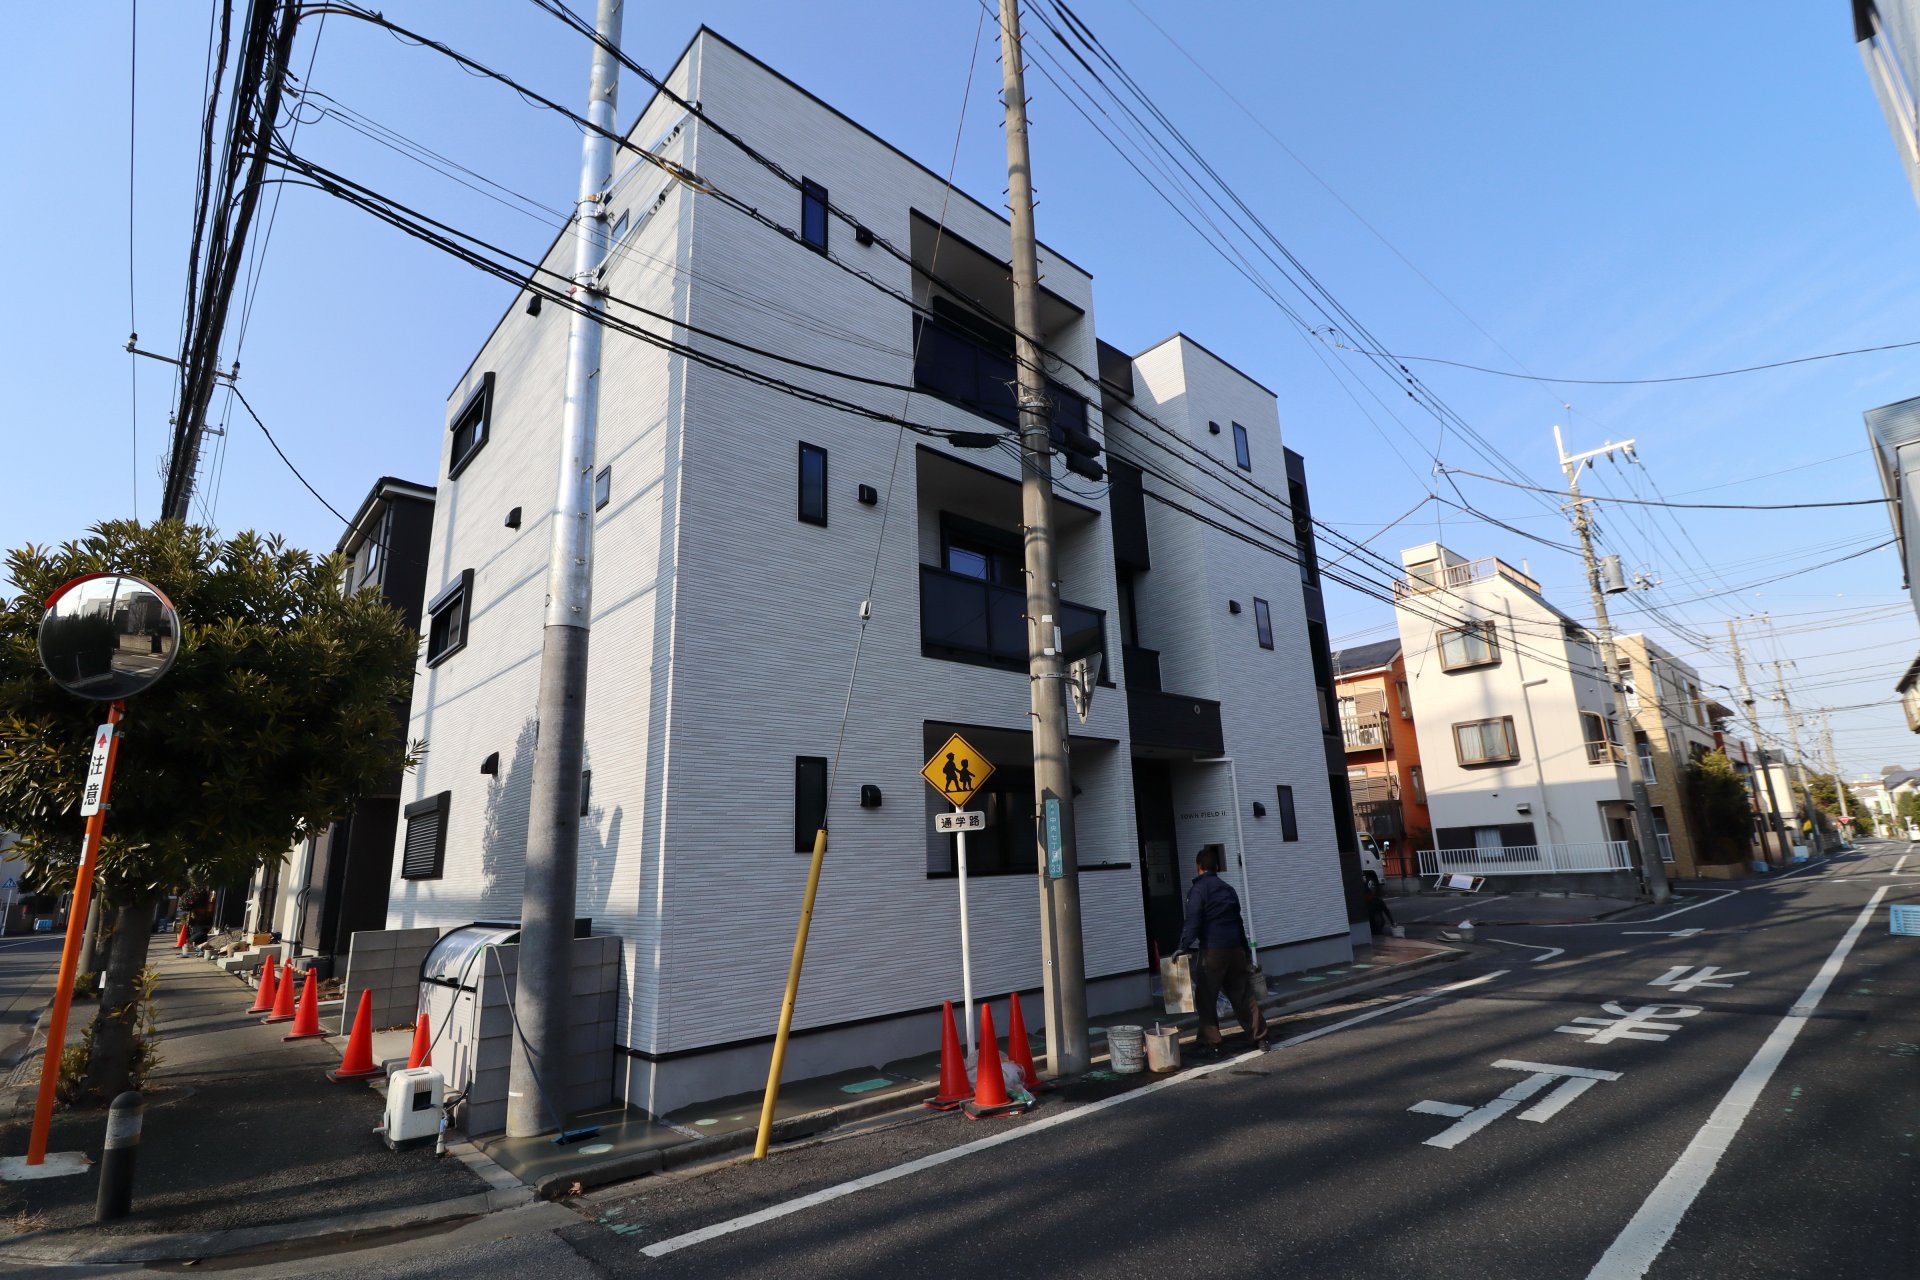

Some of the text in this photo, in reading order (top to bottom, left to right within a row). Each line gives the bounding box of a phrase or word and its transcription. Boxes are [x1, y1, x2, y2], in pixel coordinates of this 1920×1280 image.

[84, 754, 105, 806] 注意
[941, 815, 980, 829] 通学路
[1050, 864, 1061, 873] 33
[1407, 965, 1750, 1149] 止まれ
